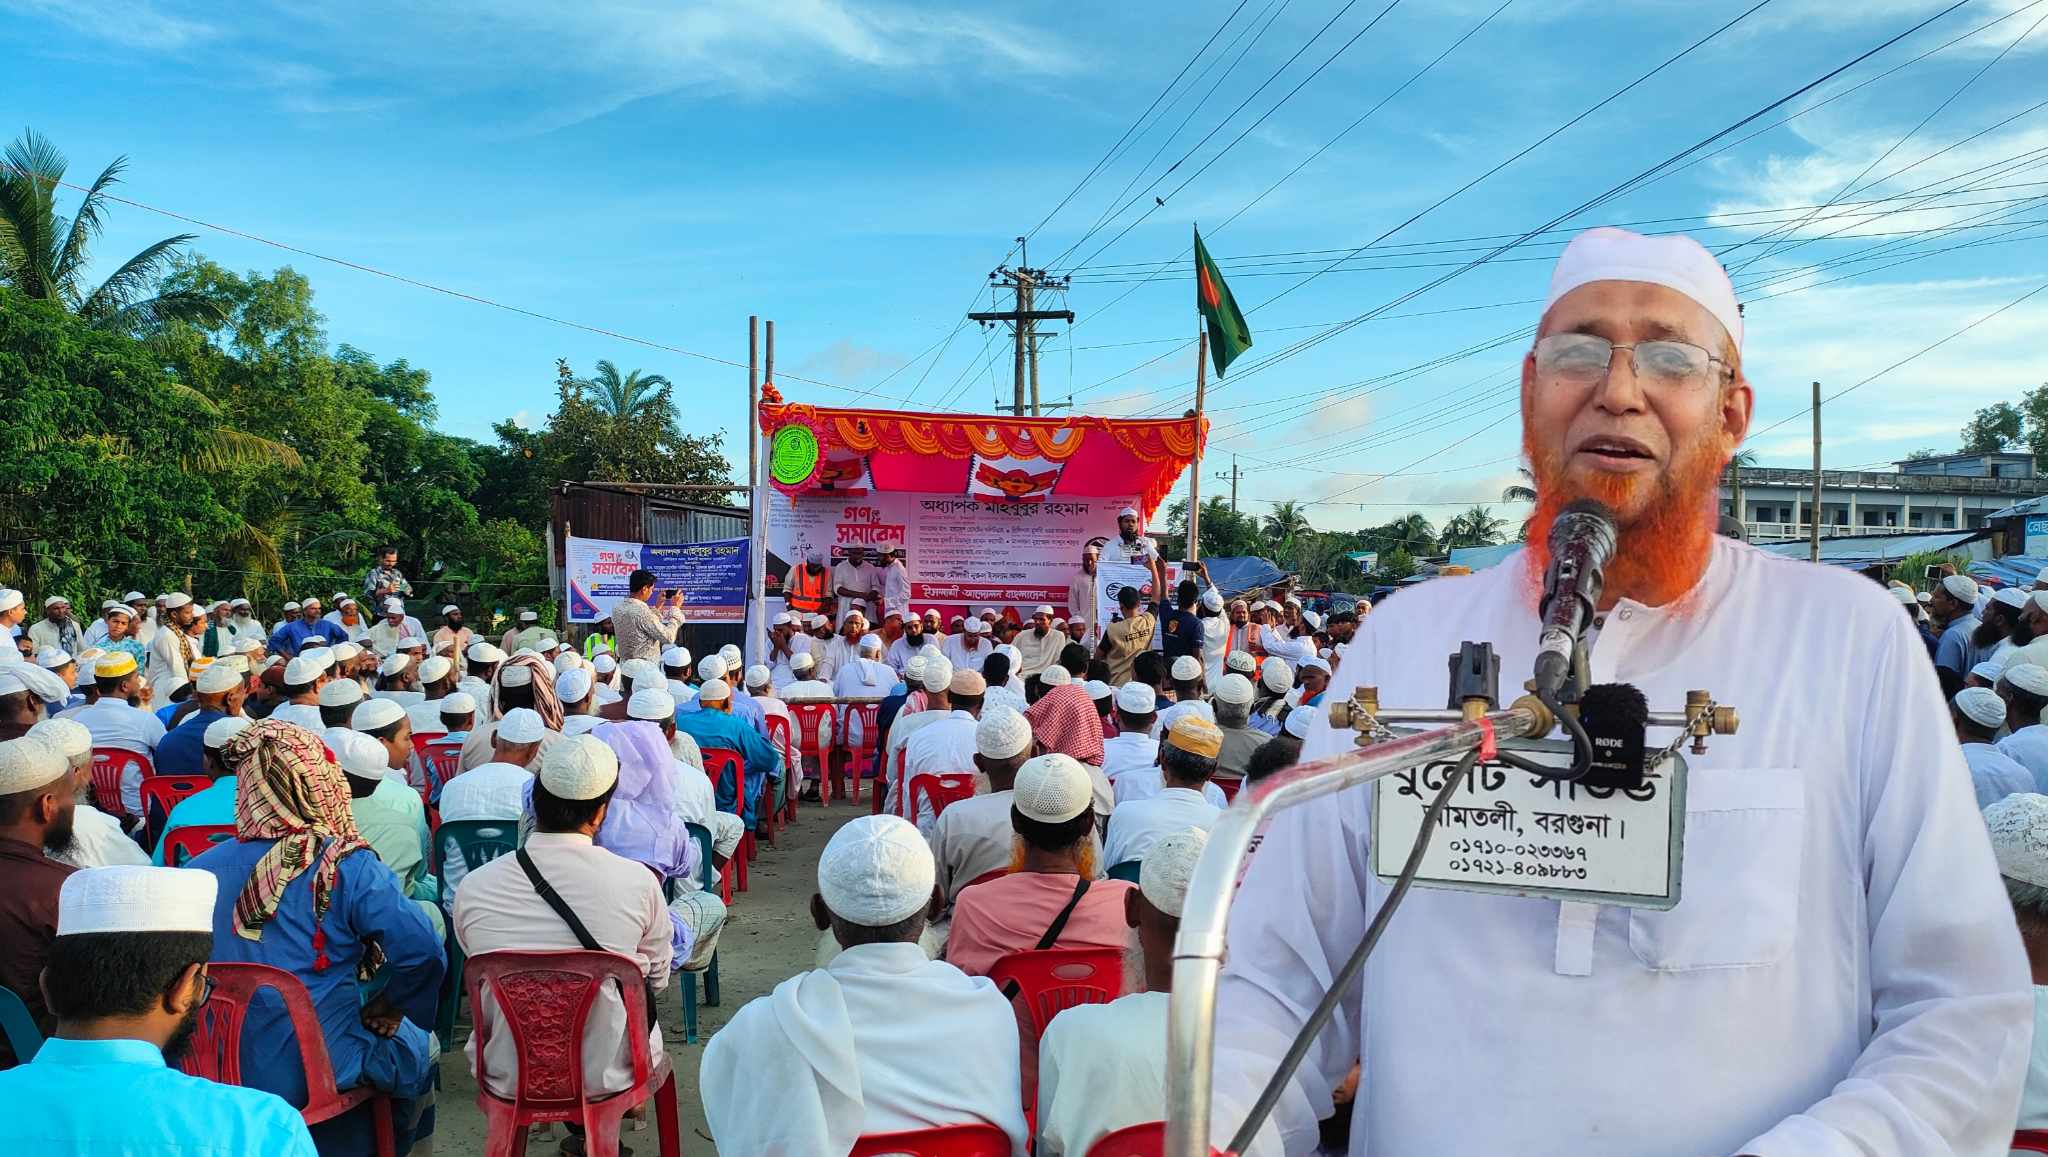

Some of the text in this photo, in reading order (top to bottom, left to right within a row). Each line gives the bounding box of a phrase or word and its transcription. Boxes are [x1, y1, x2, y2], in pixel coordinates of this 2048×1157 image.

[843, 505, 872, 523] গণ
[919, 499, 979, 514] অধ্যাপক
[1044, 501, 1090, 518] রহমান
[836, 523, 906, 545] সমাবেশ
[1449, 838, 1587, 861] ০১৭১০-০২৩৩৬৭
[1449, 857, 1587, 880] ০১৭২১-৪০৯৮৮৩
